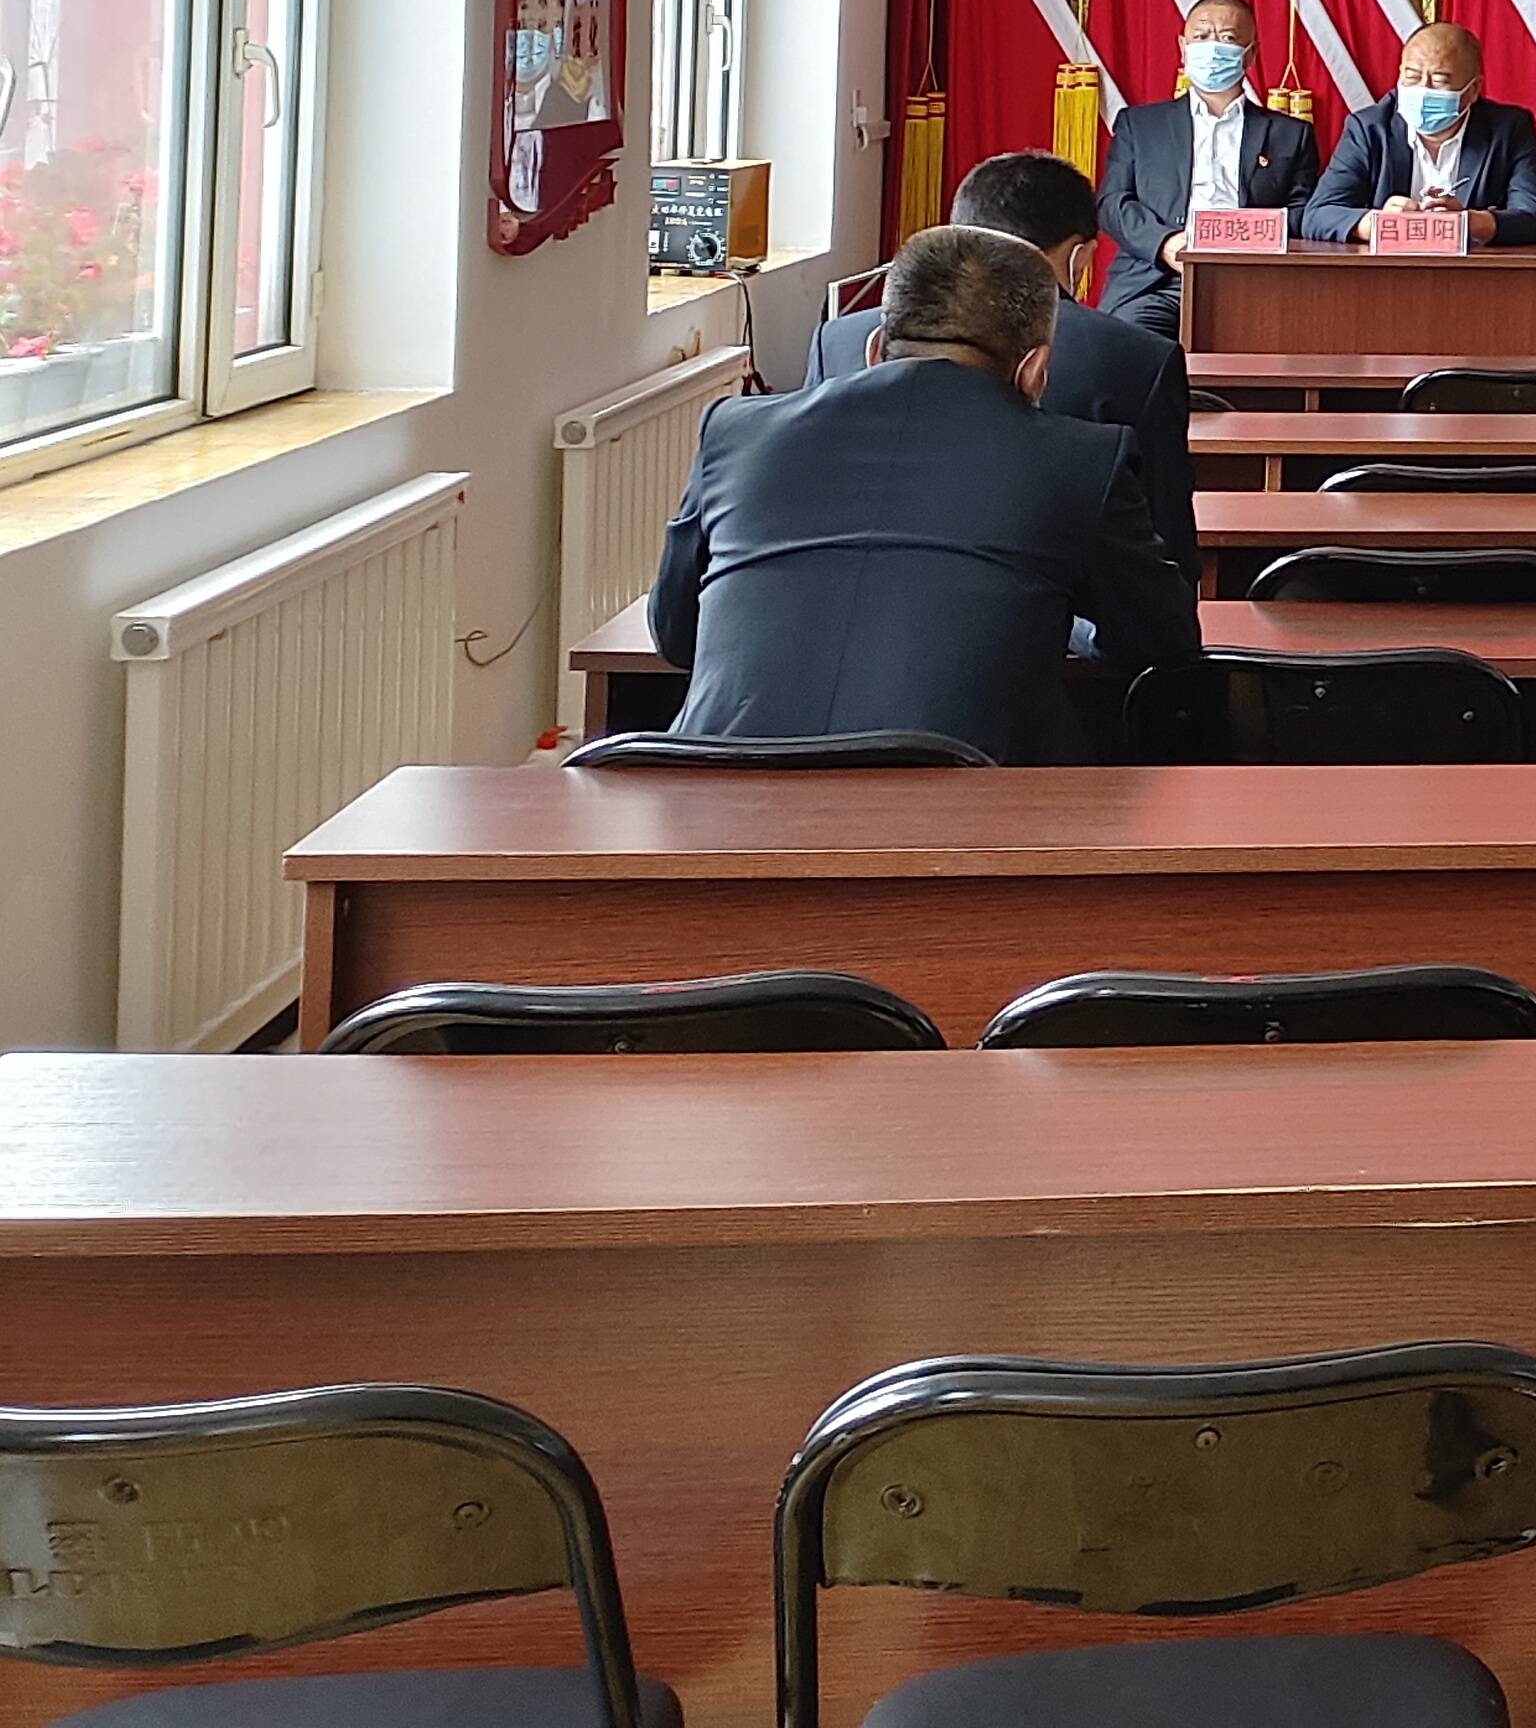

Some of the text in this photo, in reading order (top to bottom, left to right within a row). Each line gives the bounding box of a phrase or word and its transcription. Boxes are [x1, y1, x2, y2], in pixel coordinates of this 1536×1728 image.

[1198, 218, 1276, 241] 邵晓明
[1380, 218, 1455, 241] 吕国阳
